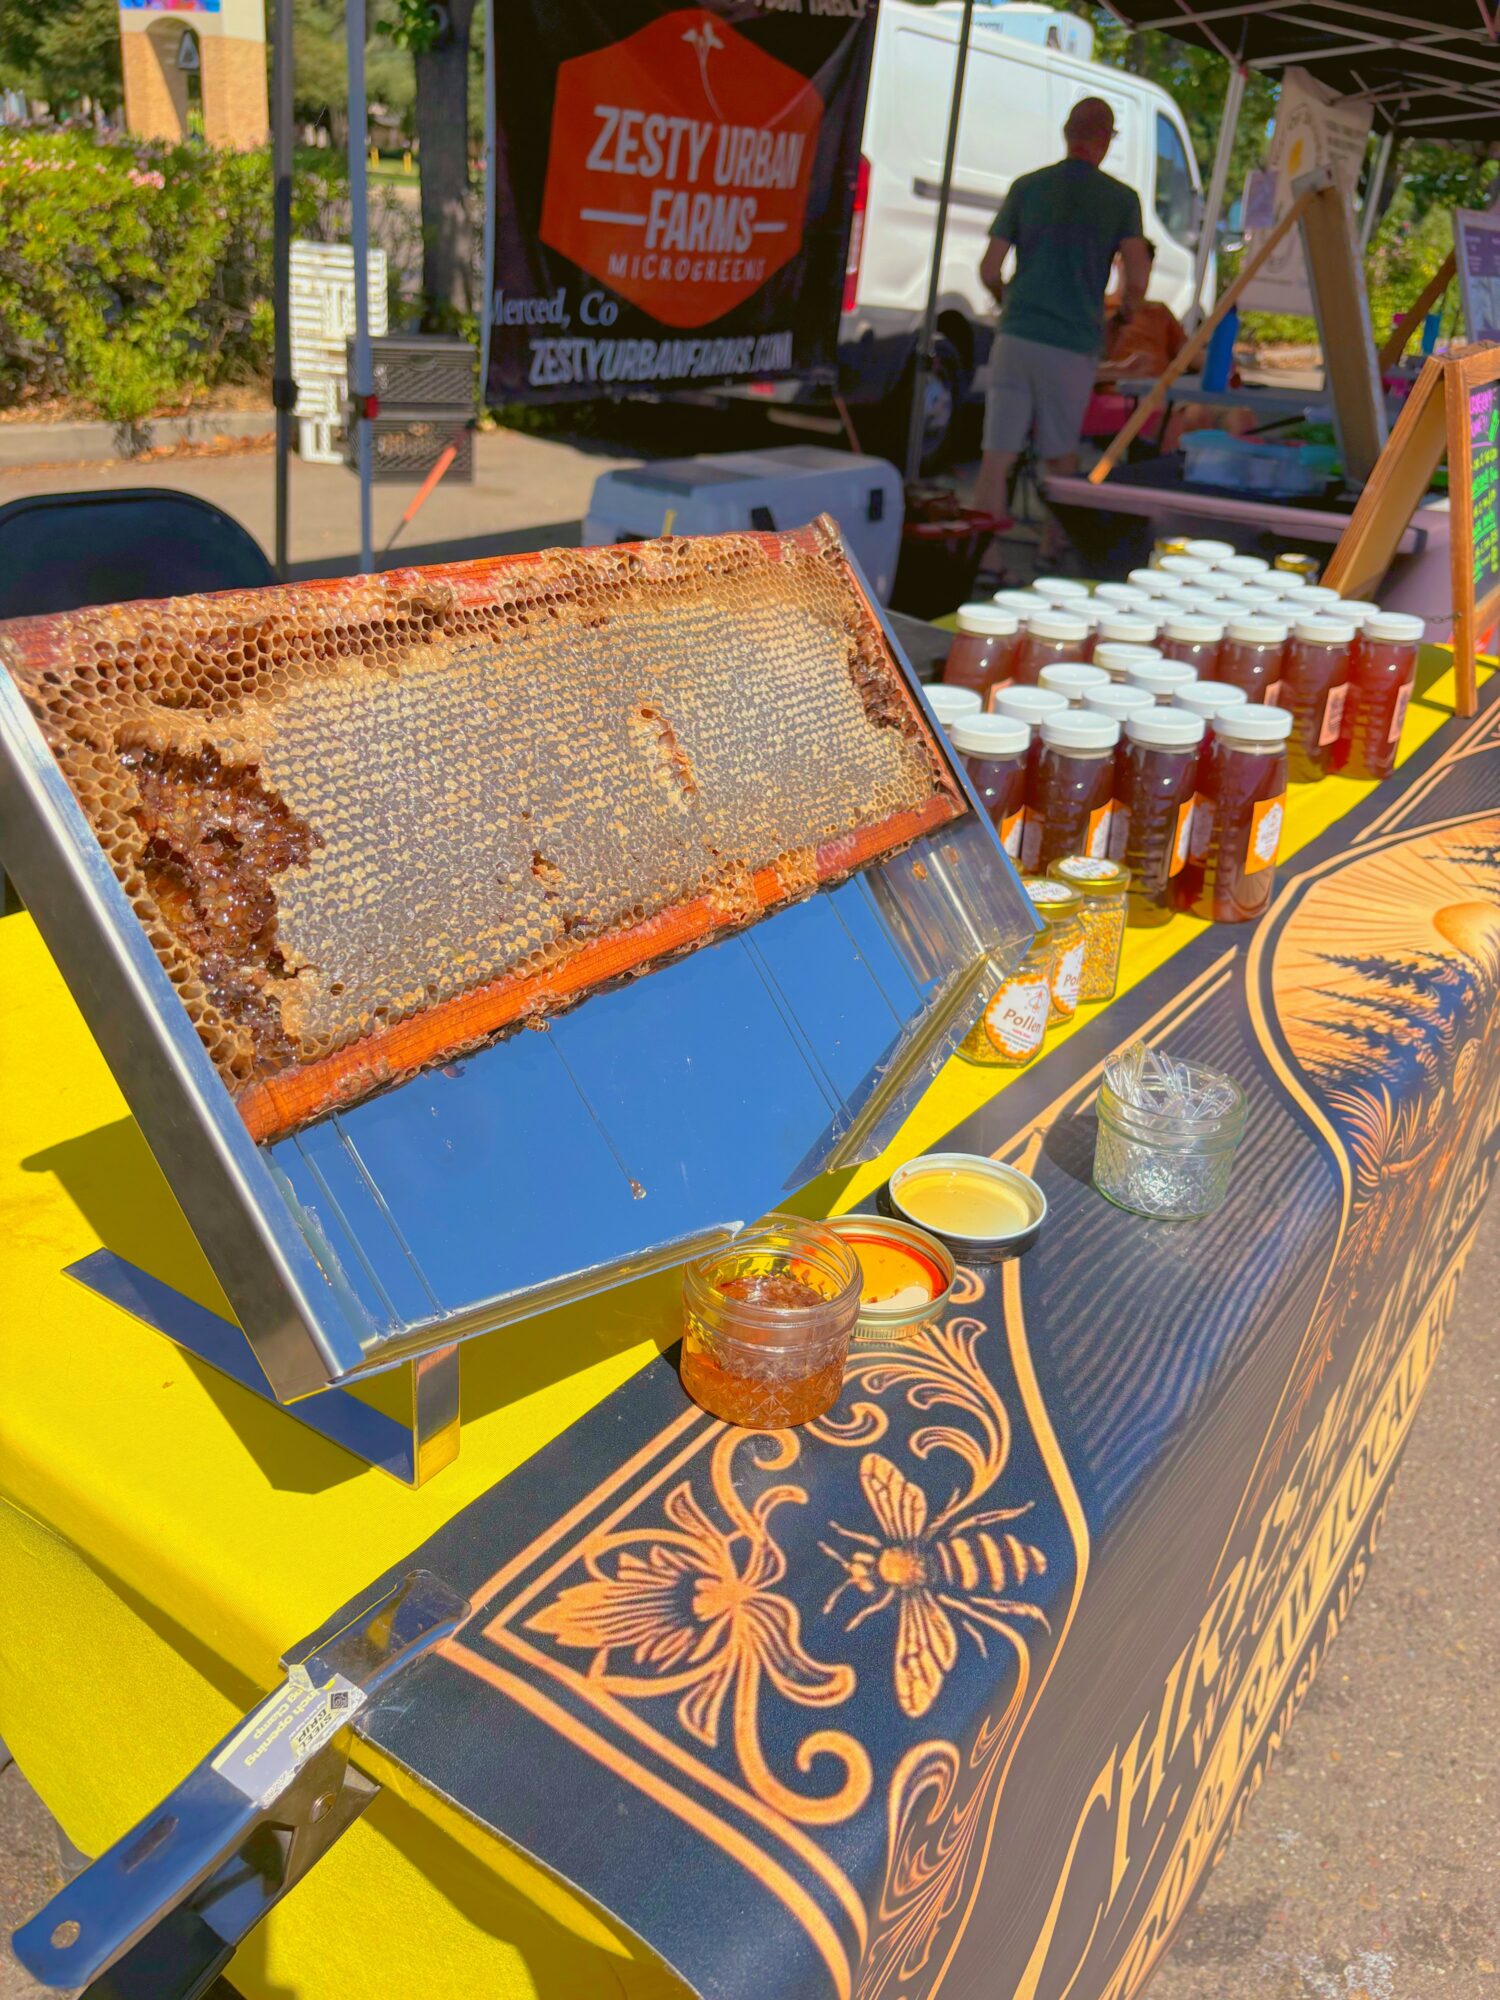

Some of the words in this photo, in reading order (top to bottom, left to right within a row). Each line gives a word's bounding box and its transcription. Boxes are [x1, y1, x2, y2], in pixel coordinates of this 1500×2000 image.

[585, 105, 713, 183] ZESTY
[713, 125, 805, 190] URBAN
[645, 189, 757, 253] FARMS
[1003, 1008, 1042, 1034] Pollen
[1236, 1538, 1320, 1765] RAW
[1331, 1360, 1416, 1552] LOCAL
[243, 1714, 294, 1767] opening
[253, 1703, 288, 1740] Clamp
[296, 1708, 328, 1744] GRIP
[298, 1712, 333, 1751] STEEL
